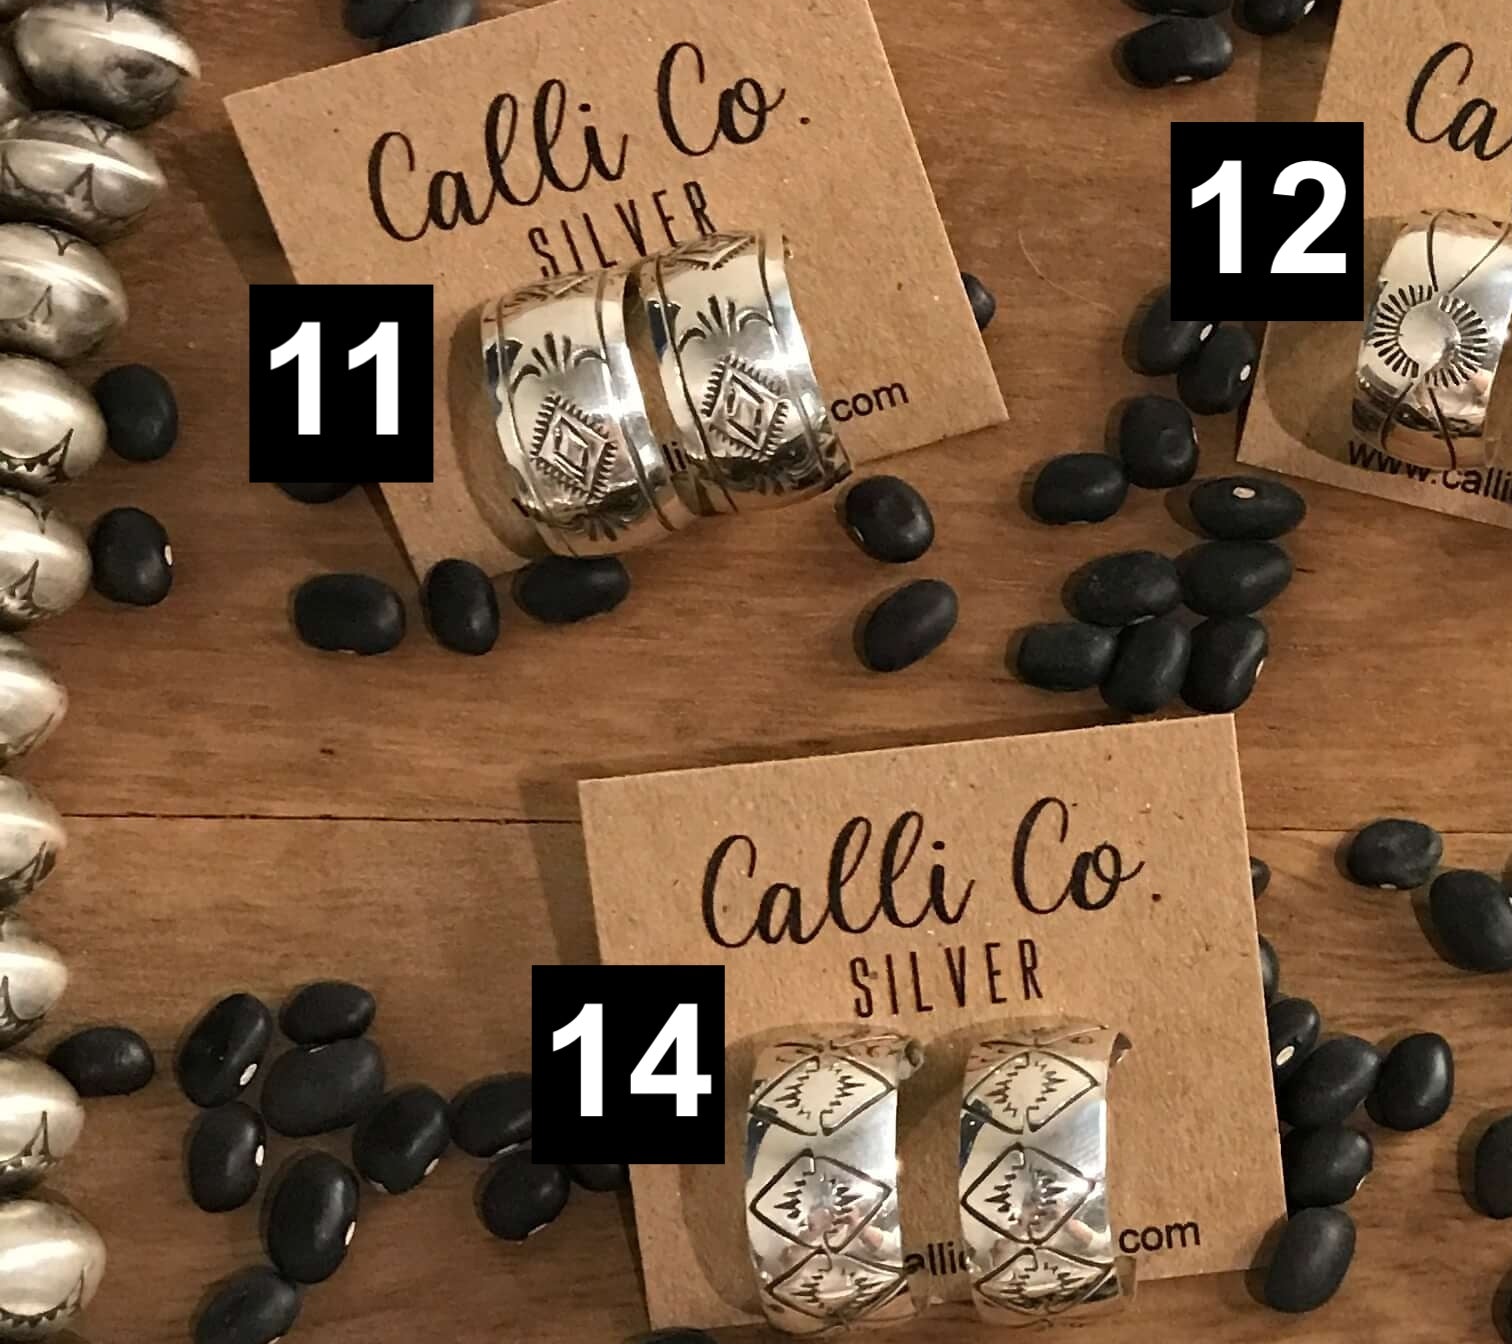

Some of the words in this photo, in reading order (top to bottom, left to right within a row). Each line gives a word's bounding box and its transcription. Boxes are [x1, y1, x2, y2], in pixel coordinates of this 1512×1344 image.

[366, 78, 628, 243] Calli
[654, 40, 812, 158] Co.
[527, 180, 717, 278] SILVER
[700, 809, 976, 949] Calli
[1010, 795, 1162, 914] Co.
[849, 938, 1044, 1018] SILVER
